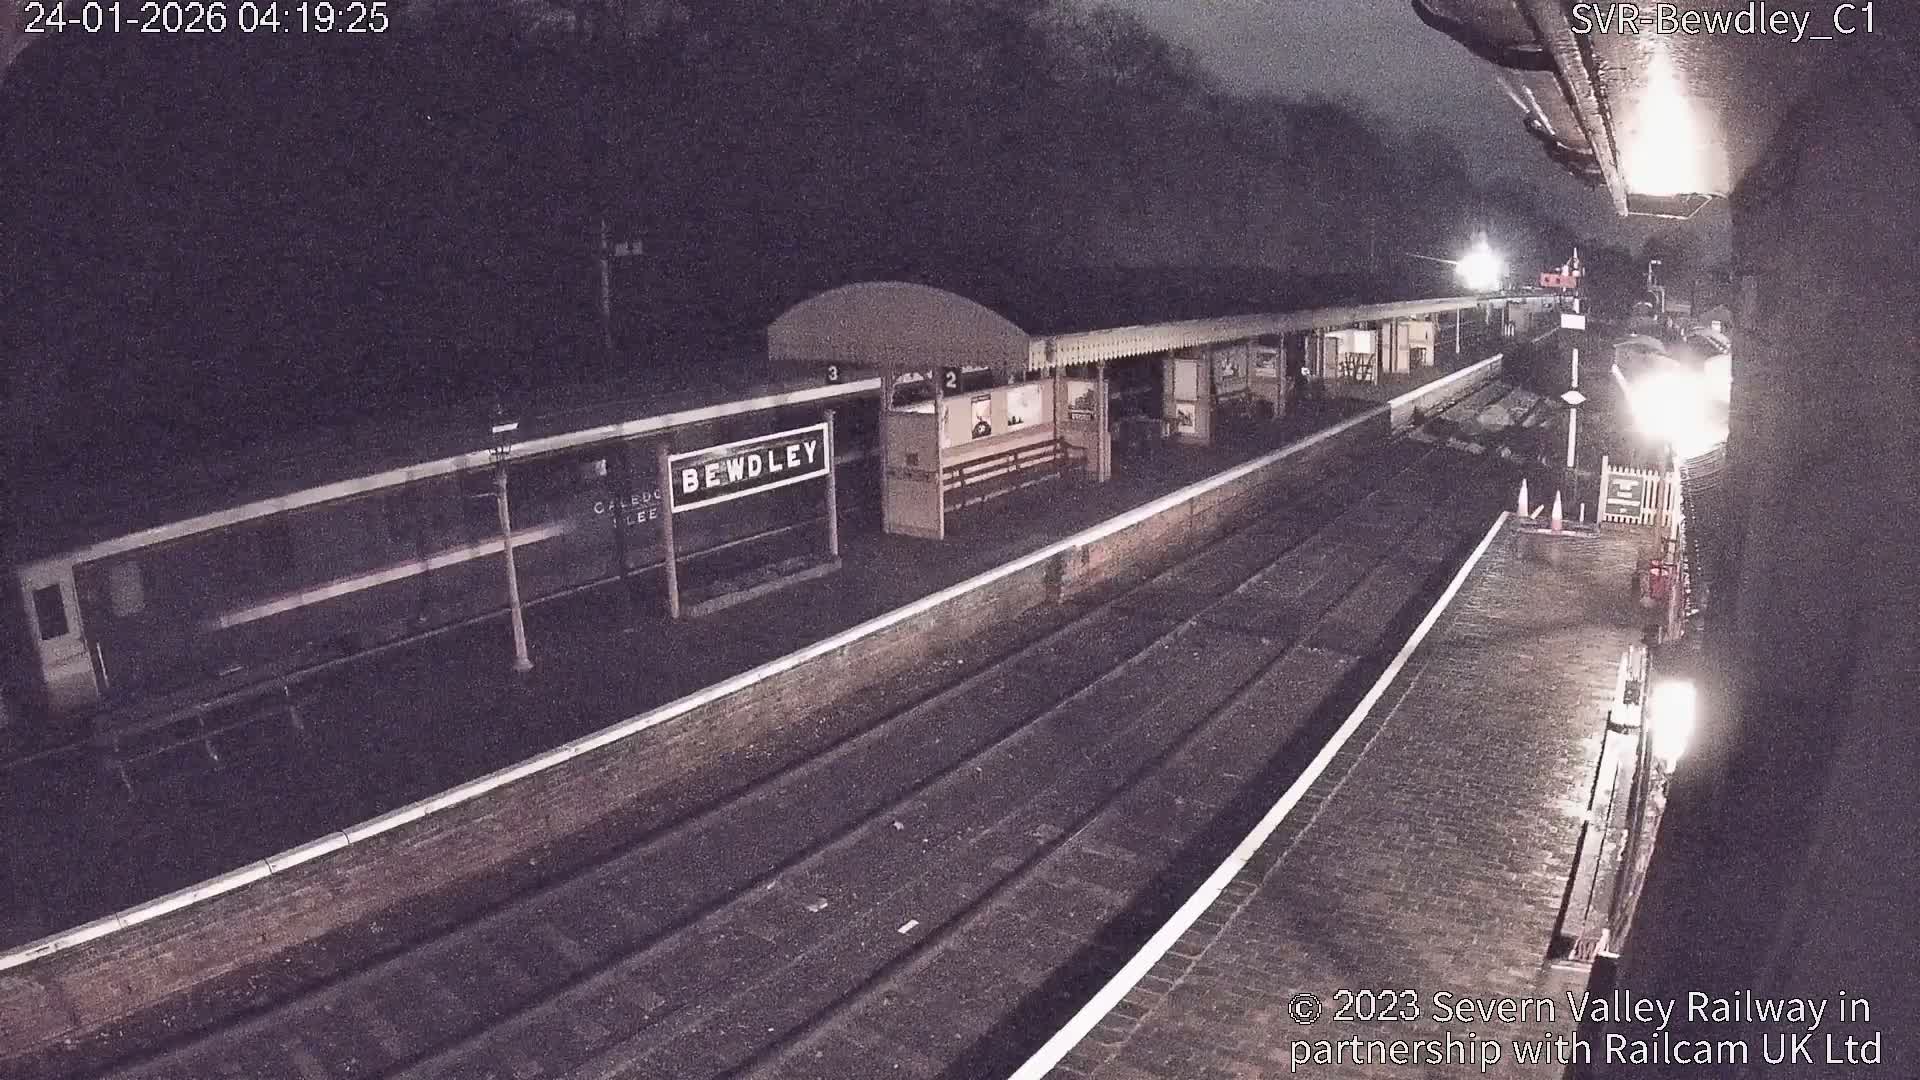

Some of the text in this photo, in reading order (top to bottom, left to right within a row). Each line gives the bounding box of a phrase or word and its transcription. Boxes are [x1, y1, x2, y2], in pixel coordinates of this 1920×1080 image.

[828, 365, 838, 381] 3
[946, 371, 957, 389] 2
[681, 439, 817, 494] BEWDLEY
